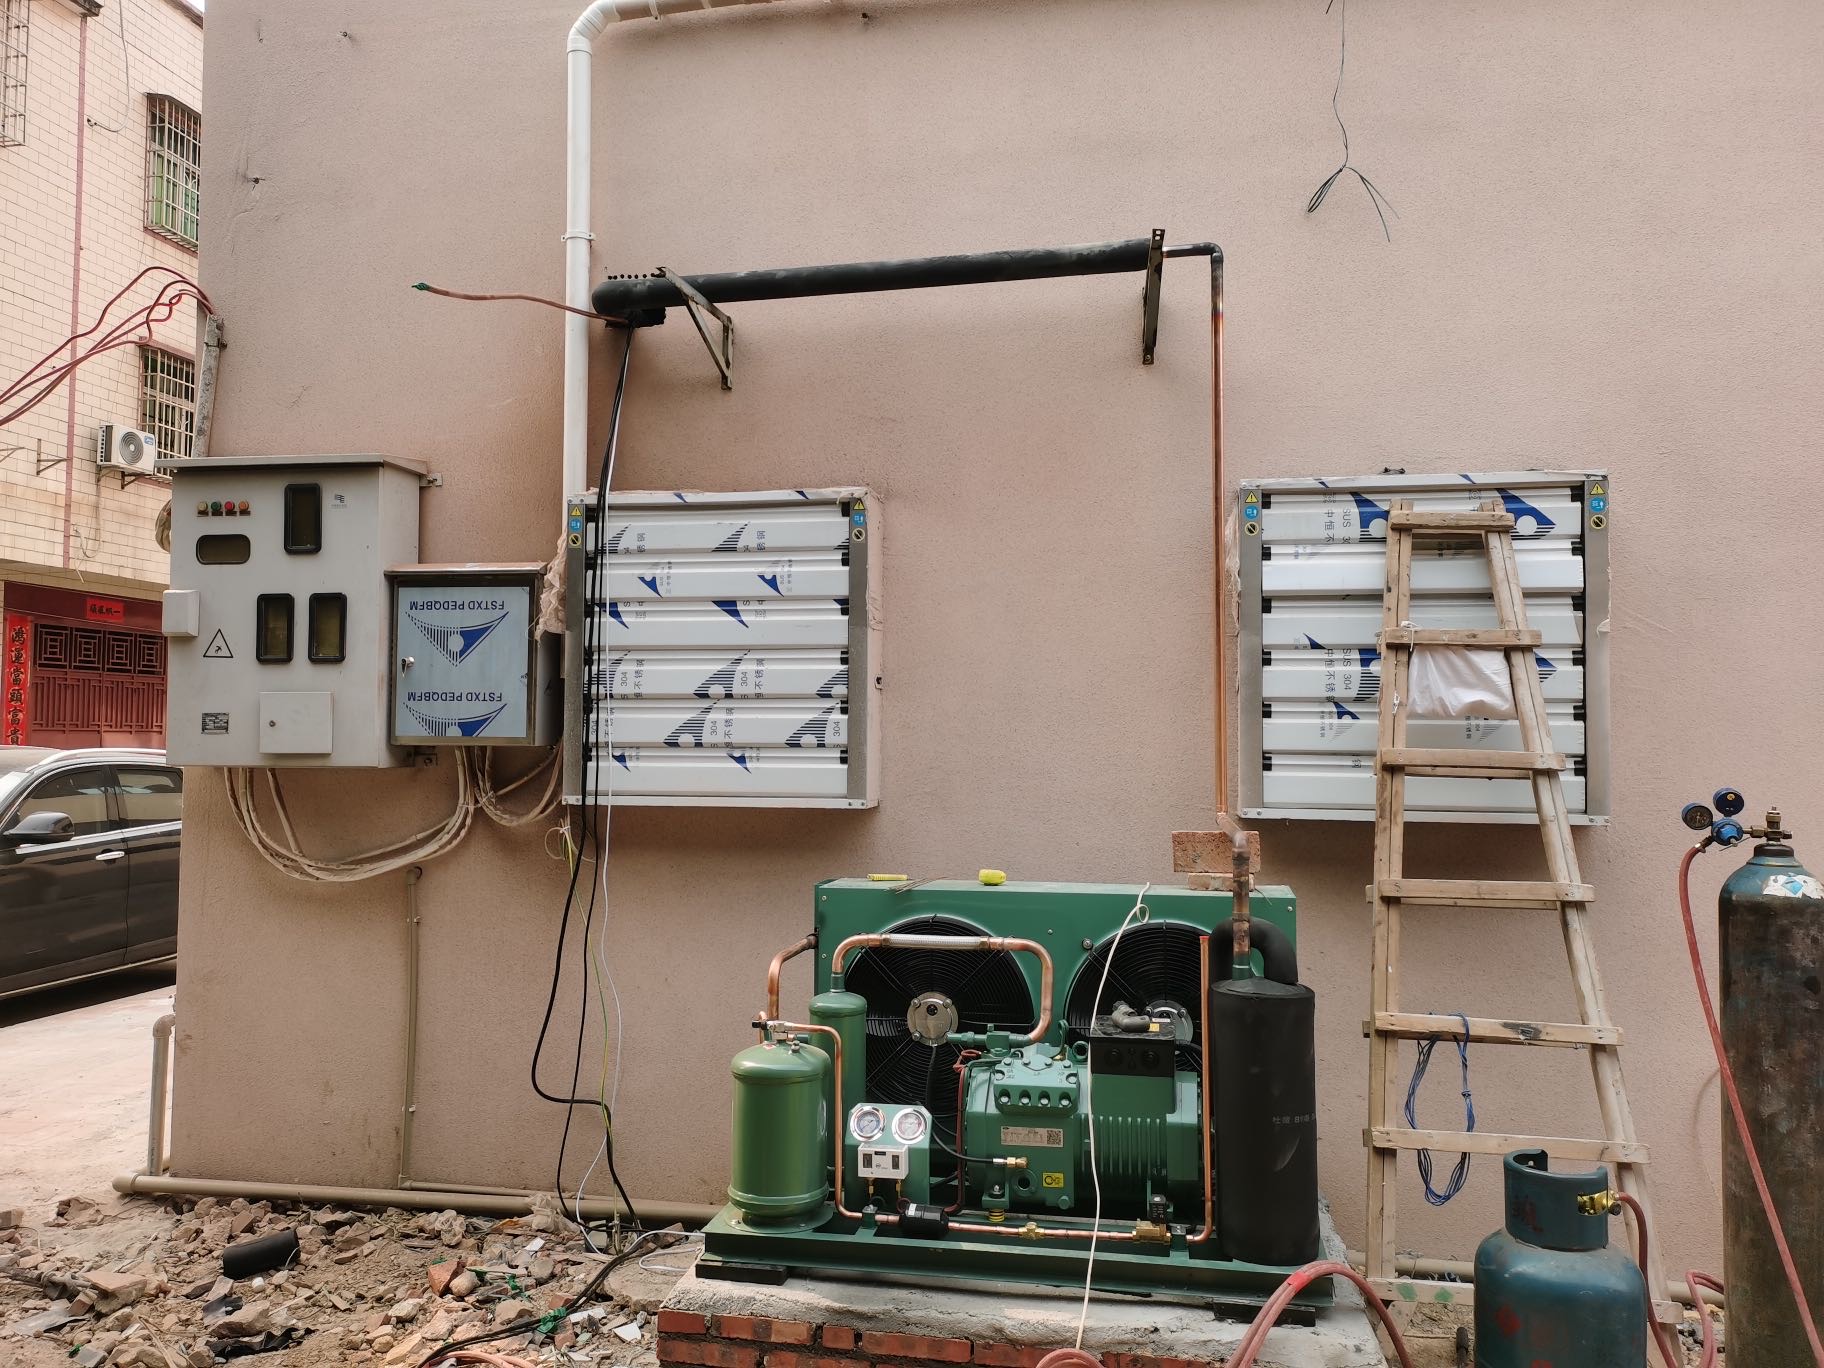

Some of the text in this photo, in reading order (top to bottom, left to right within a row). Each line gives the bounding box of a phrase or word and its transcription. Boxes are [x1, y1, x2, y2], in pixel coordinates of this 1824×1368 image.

[409, 600, 505, 610] FSTXD PEDQBFM
[1343, 648, 1352, 690] SUS 304
[620, 671, 628, 687] 304
[740, 671, 748, 687] 304
[407, 691, 503, 702] FSTXD PEDQBFM
[710, 720, 718, 736] 304
[832, 721, 841, 737] 304
